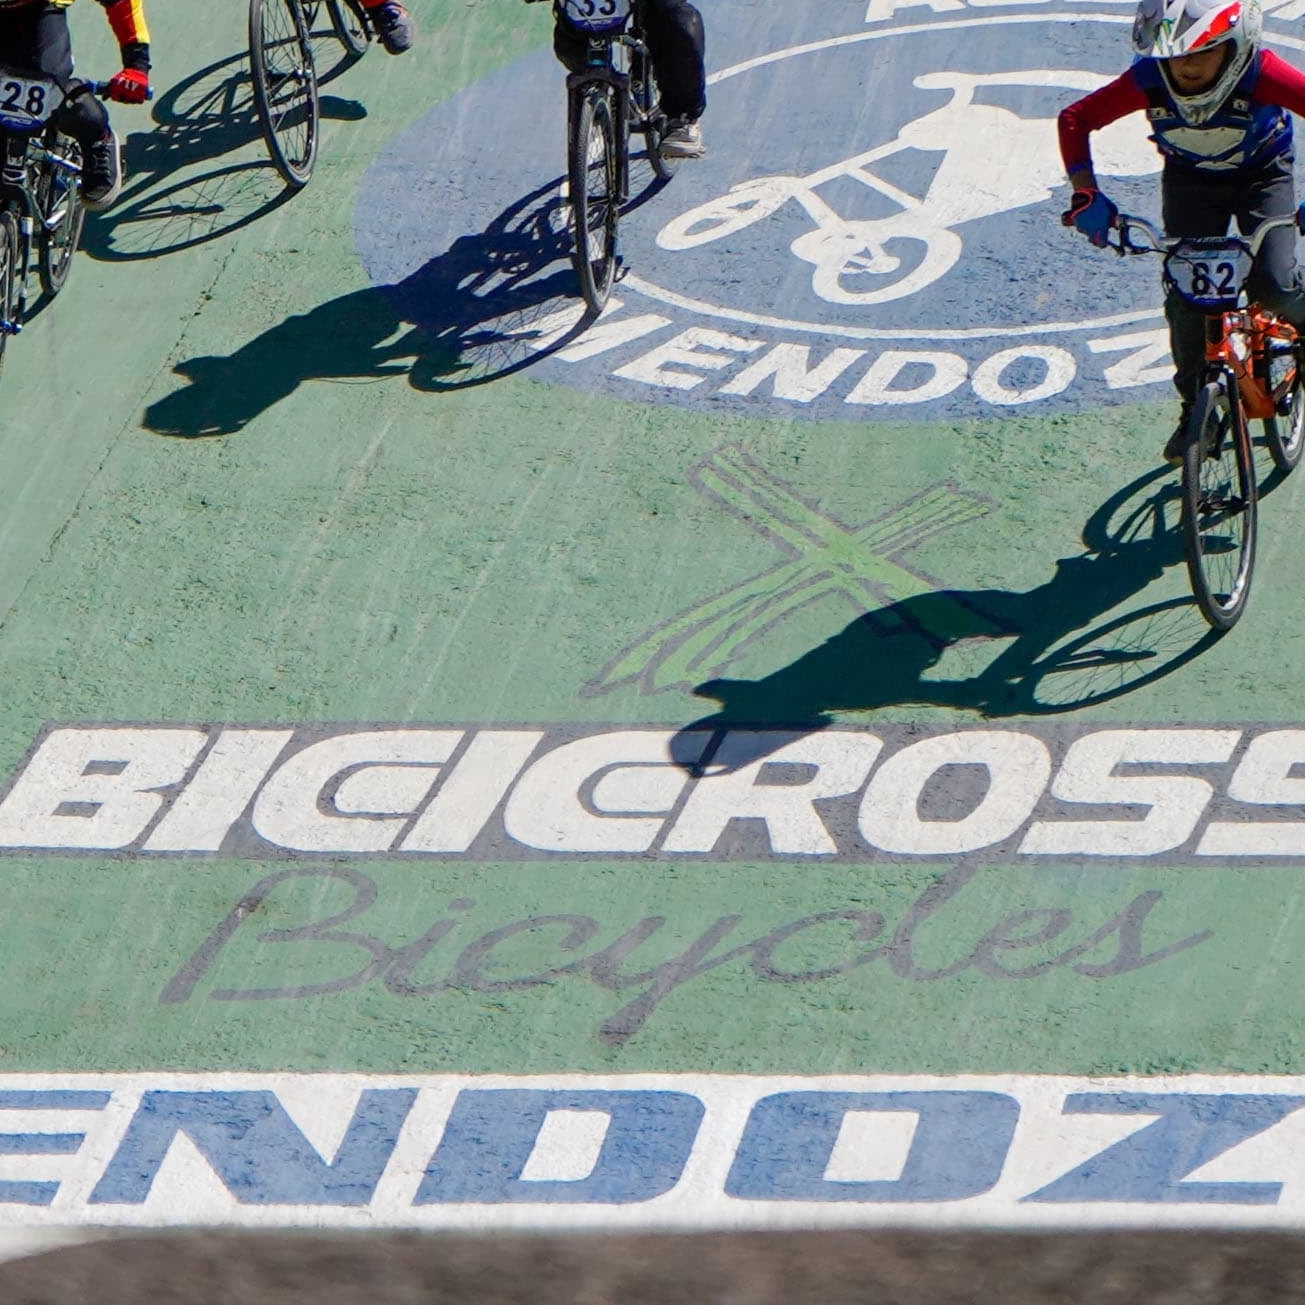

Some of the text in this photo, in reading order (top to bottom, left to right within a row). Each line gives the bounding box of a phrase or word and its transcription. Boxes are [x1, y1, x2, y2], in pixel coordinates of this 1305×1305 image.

[1, 81, 45, 116] 28
[116, 77, 139, 92] FLY
[1192, 262, 1235, 295] 82
[158, 864, 1212, 1045] Bicycles
